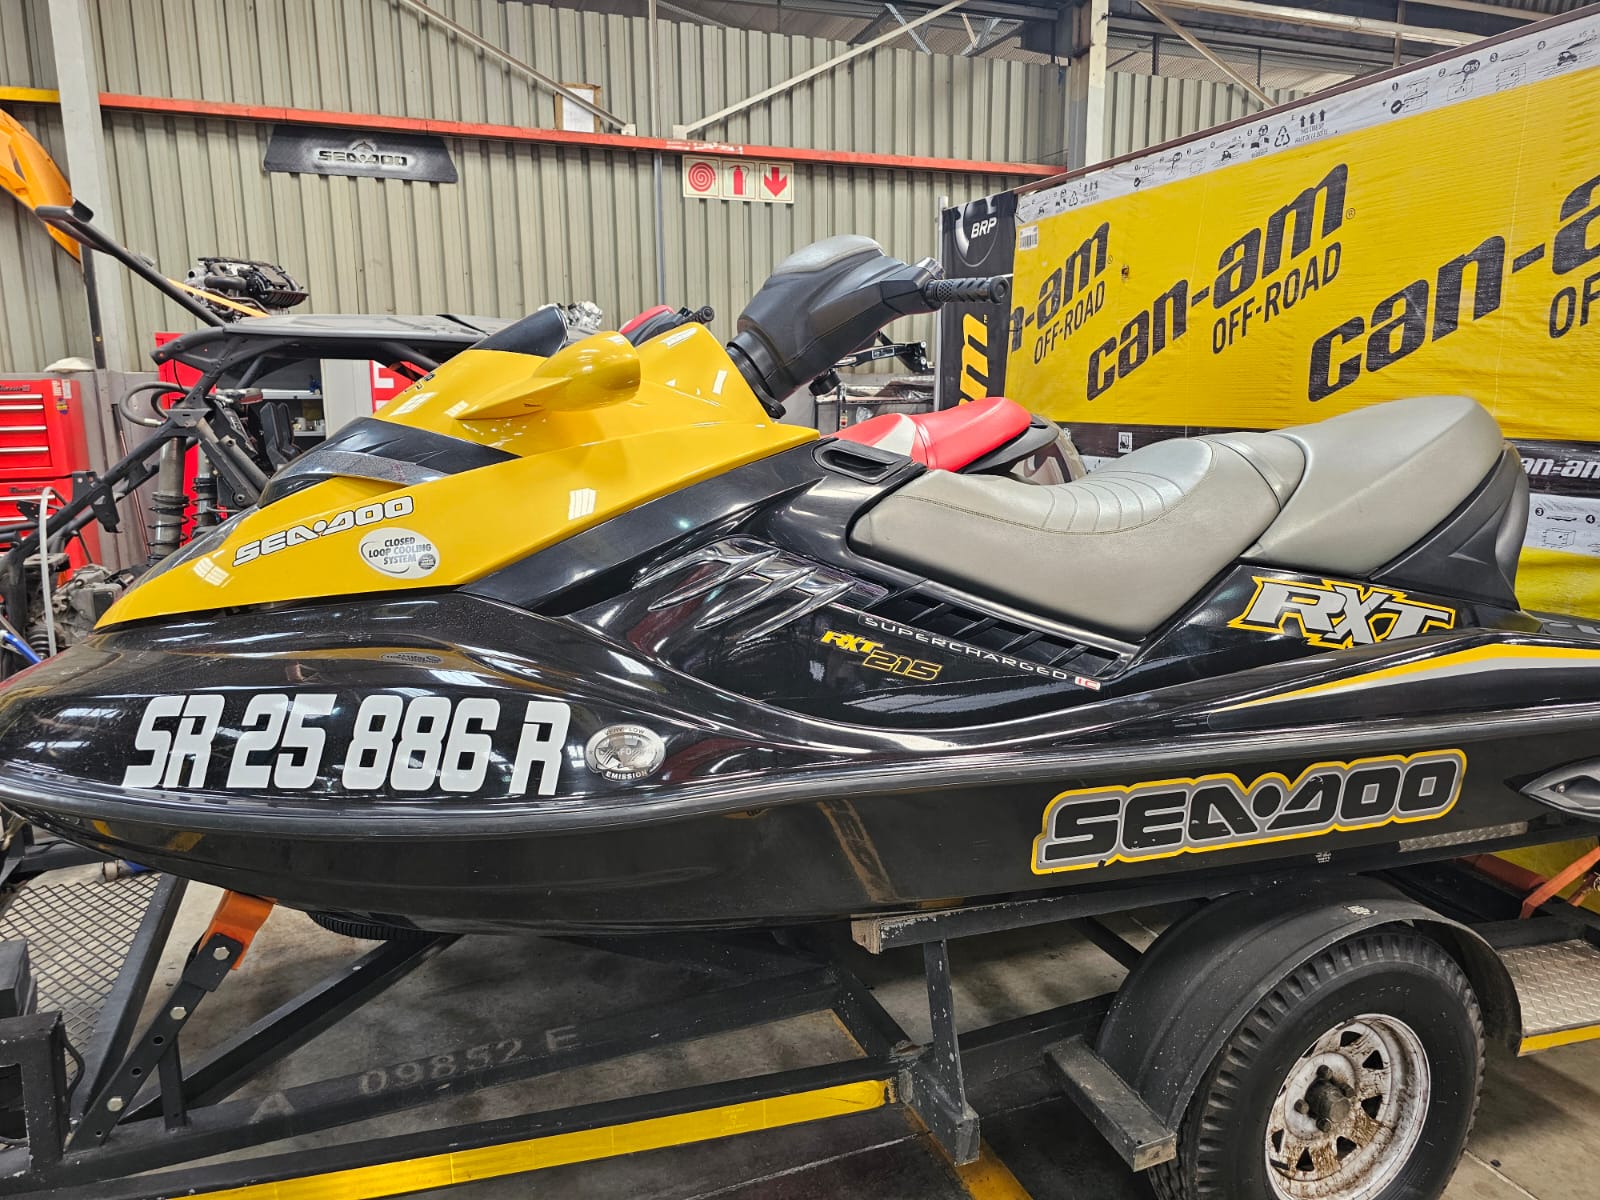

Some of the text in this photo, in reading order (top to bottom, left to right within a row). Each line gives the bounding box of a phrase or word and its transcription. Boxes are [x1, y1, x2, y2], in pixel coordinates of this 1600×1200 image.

[970, 217, 998, 239] BRP
[1009, 222, 1110, 353] n-am
[1087, 163, 1349, 402] can-am
[1212, 241, 1342, 355] OFF-ROAD
[1308, 174, 1600, 402] can-a
[1548, 270, 1600, 339] OF
[1033, 280, 1105, 365] OFF-ROAD
[368, 543, 432, 558] LOOP COOLING
[383, 553, 417, 566] SYSTEM
[384, 536, 416, 548] CLOSED
[820, 628, 884, 655] RXT
[1234, 577, 1453, 648] RXT
[862, 649, 943, 681] 215
[864, 616, 1068, 681] SUPERCHARGED
[122, 693, 571, 796] SR 25 886 R
[605, 769, 648, 780] EMISSION
